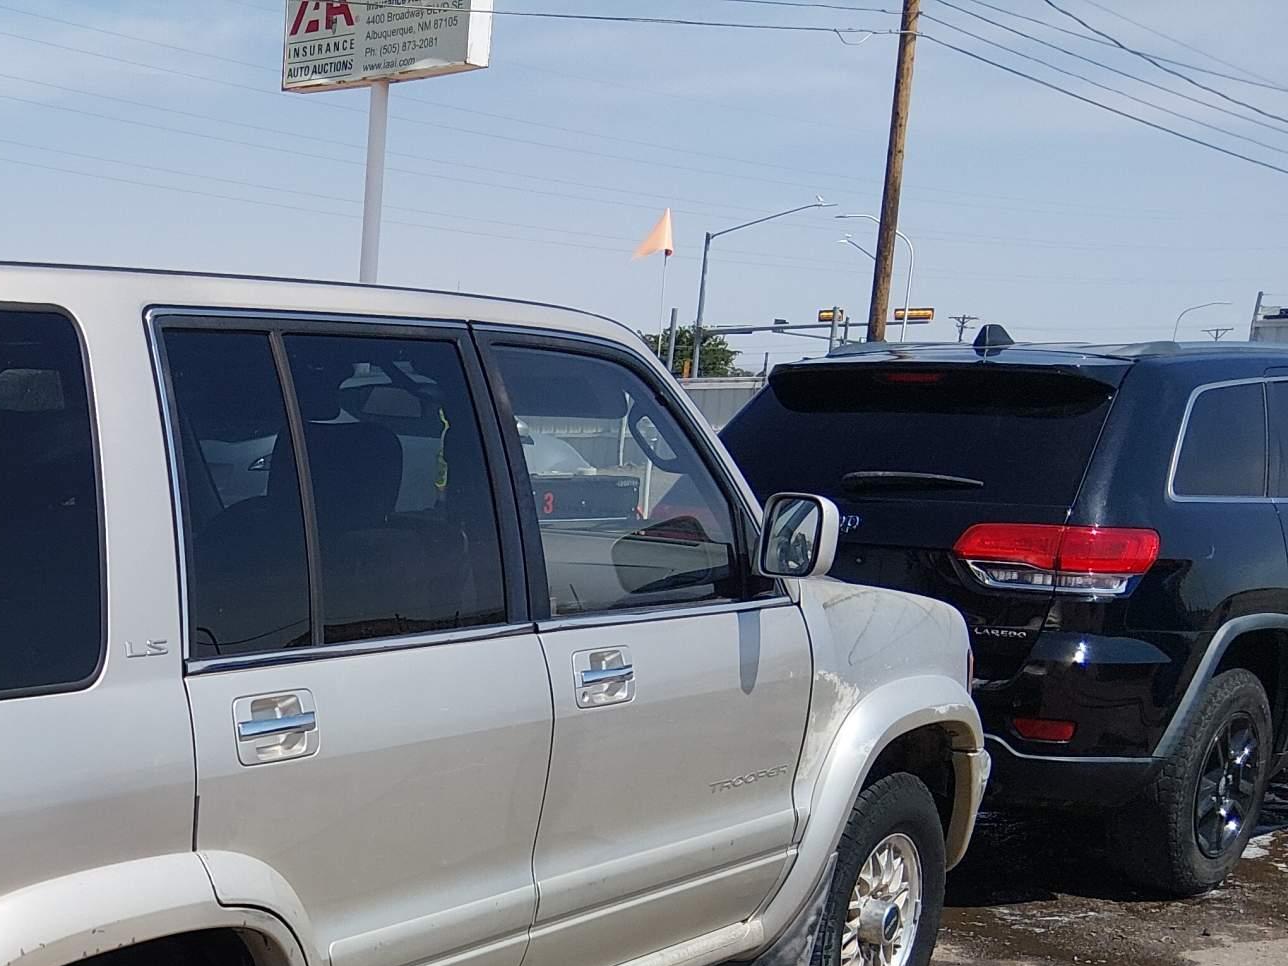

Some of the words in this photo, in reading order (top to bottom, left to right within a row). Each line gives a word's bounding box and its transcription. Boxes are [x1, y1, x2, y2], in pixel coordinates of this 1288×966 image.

[366, 14, 385, 25] 4400
[387, 8, 424, 21] Broadway
[418, 20, 431, 32] NM
[433, 15, 459, 29] 87105
[287, 38, 355, 60] INSURANCE
[379, 42, 400, 56] (505)
[287, 64, 310, 80] AUTO
[311, 59, 354, 77] AUCTIONS
[974, 627, 1027, 638] LAREDO
[124, 639, 169, 659] LS
